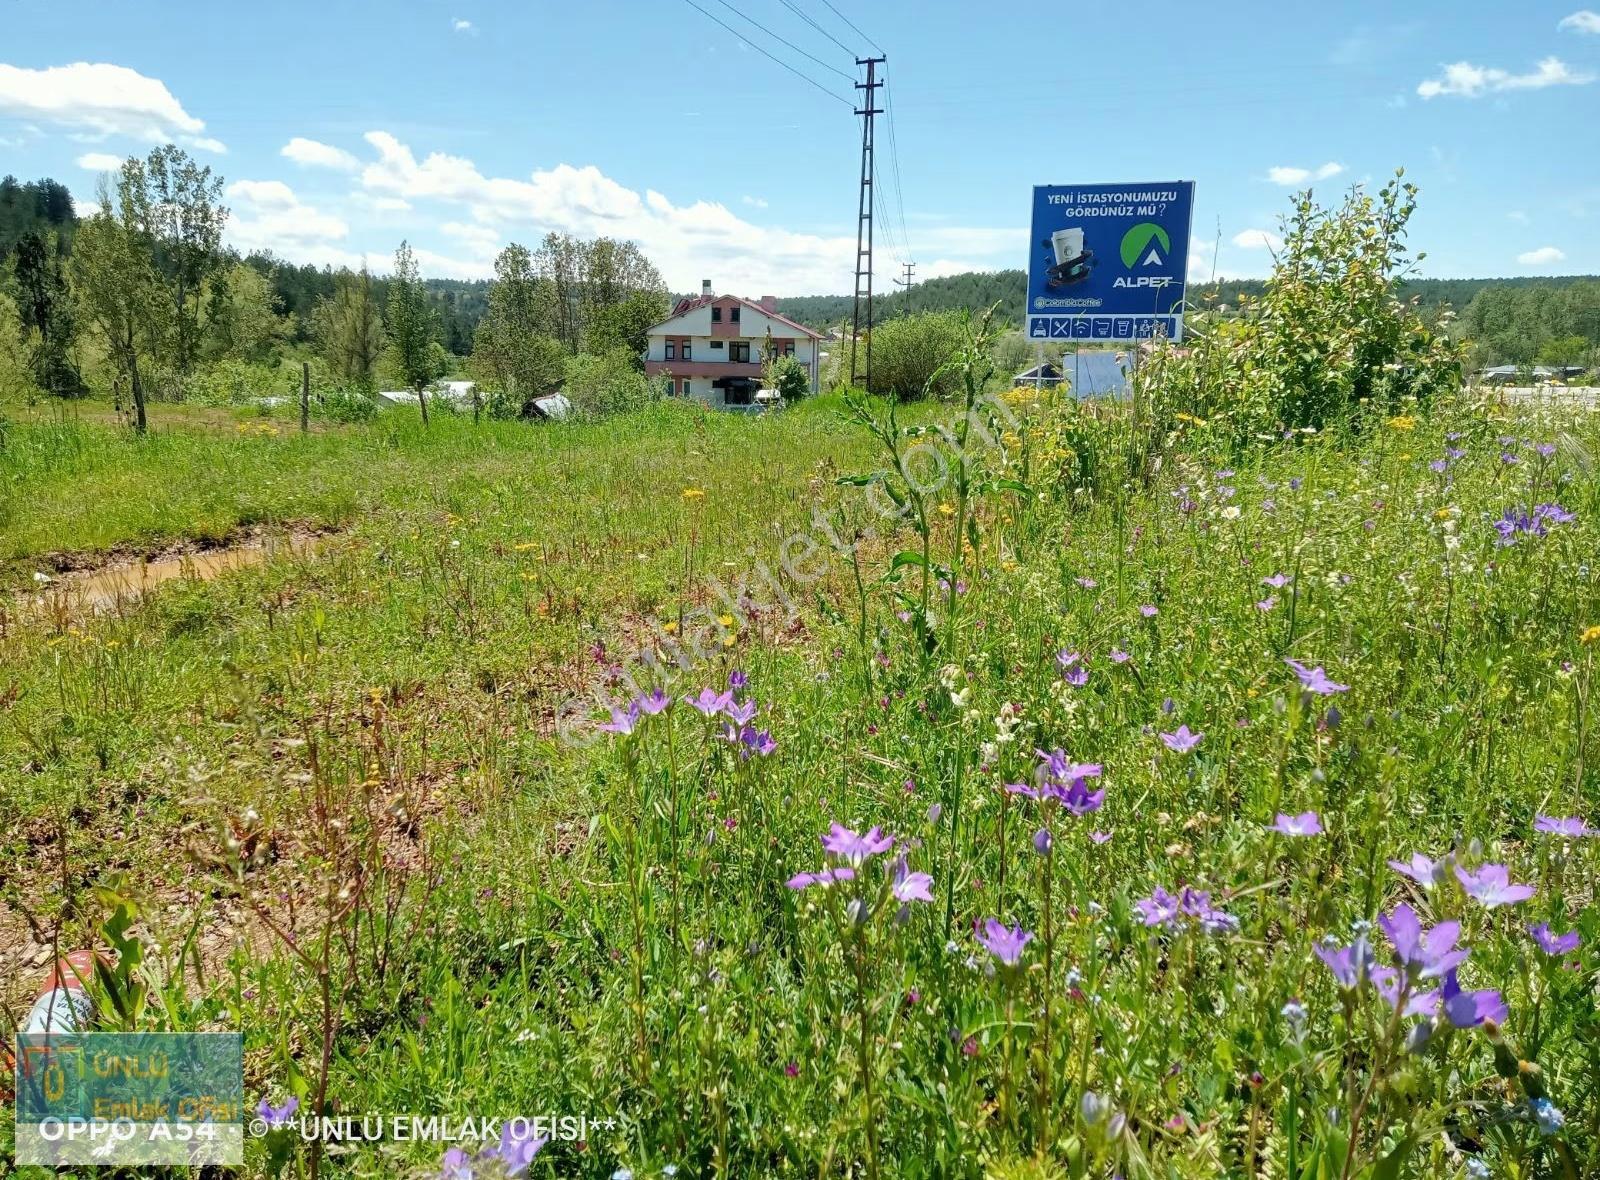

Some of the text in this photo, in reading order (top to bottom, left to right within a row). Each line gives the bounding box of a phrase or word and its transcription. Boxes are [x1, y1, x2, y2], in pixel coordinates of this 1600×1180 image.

[1048, 191, 1177, 204] YENİ İSTASYONUMUZU
[1066, 205, 1134, 217] GÖRDÜNÜZ
[1112, 276, 1173, 288] ALPET
